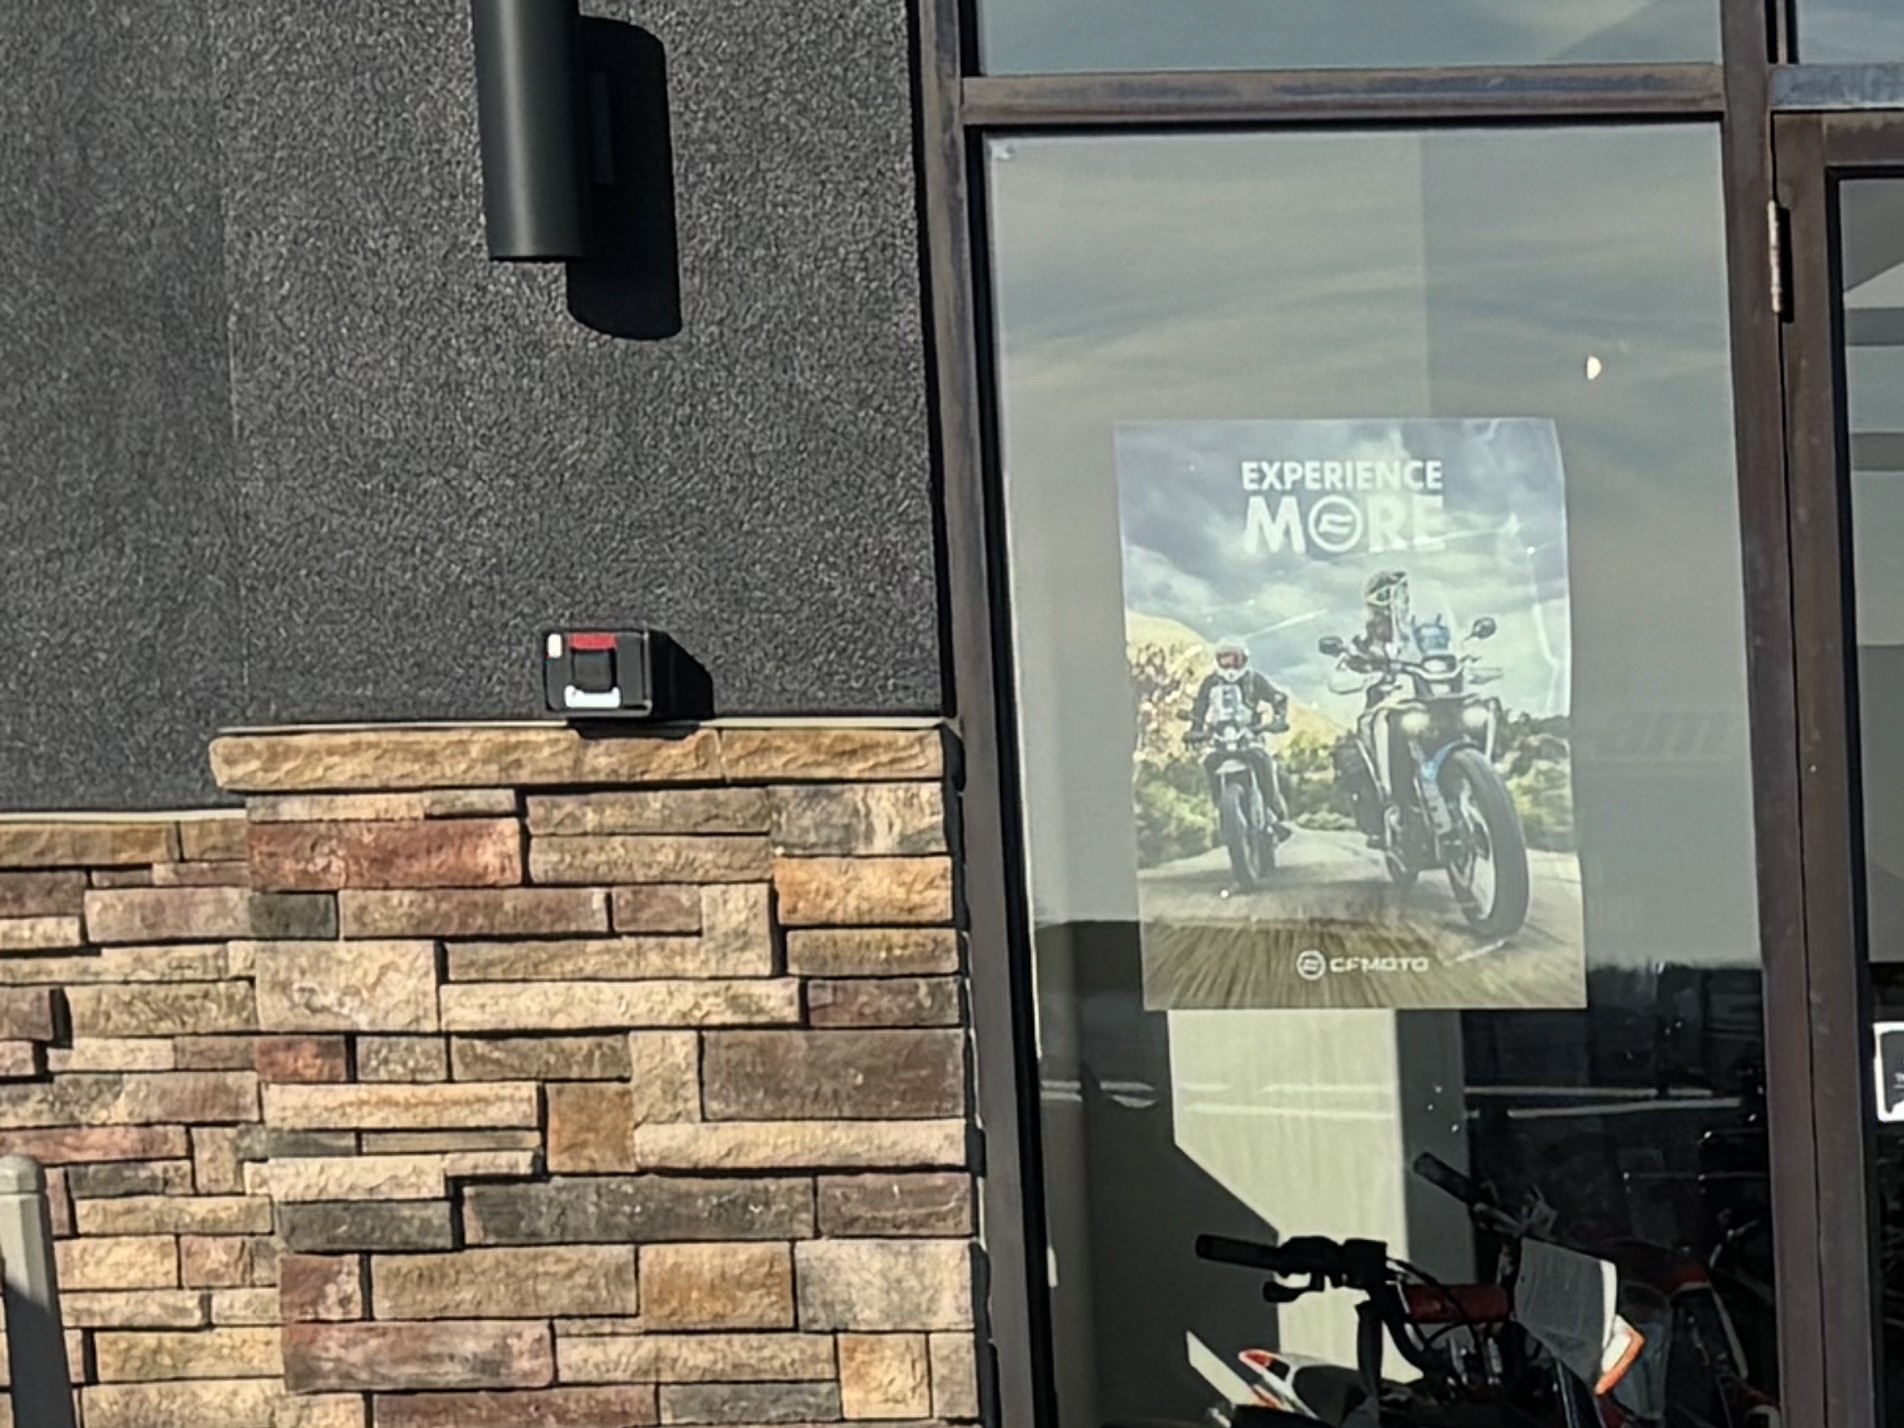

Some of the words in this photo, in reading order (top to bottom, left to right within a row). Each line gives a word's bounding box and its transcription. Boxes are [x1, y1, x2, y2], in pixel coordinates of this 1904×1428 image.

[1241, 460, 1443, 491] EXPERIENCE
[1244, 494, 1446, 553] MORE
[1330, 956, 1430, 973] CFMOTO
